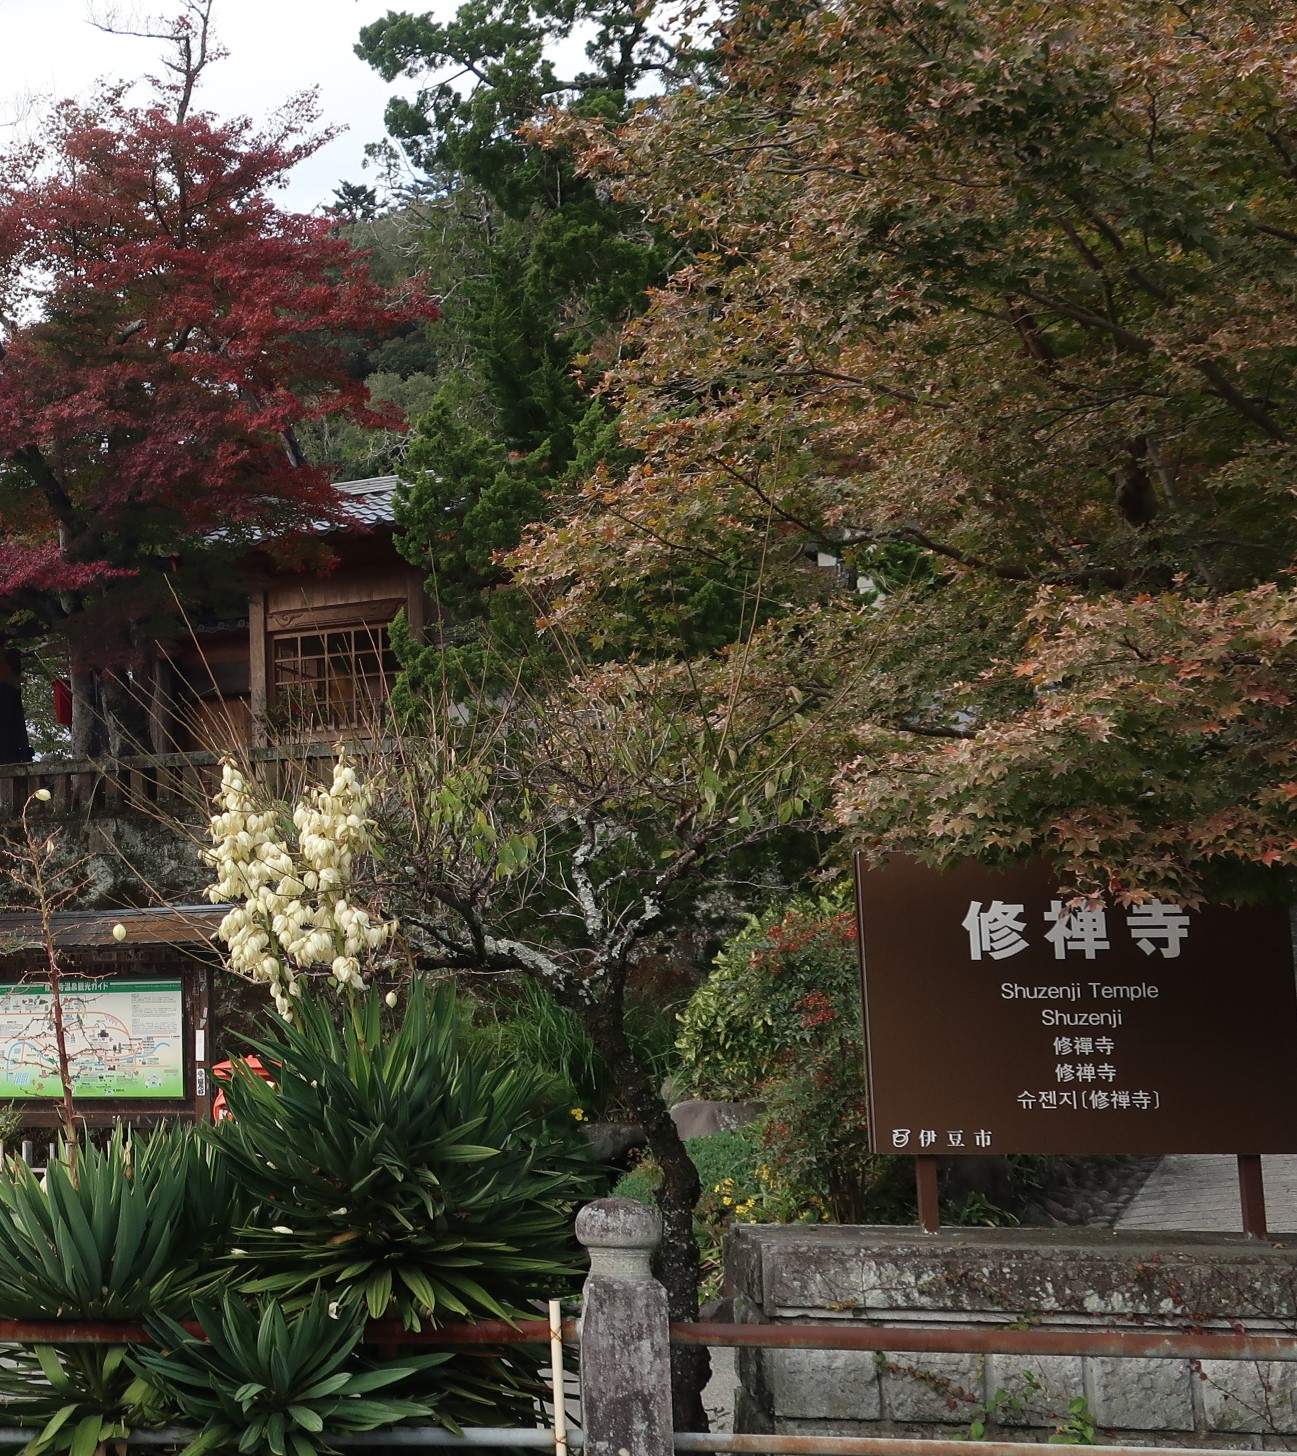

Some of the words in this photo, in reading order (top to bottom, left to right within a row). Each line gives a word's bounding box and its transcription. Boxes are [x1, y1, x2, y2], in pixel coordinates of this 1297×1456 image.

[962, 899, 1190, 961] 修禅寺
[45, 982, 109, 991] 修寺温泉観光ガイド
[1001, 982, 1081, 1002] Shuzenji
[1087, 982, 1160, 1001] Temple
[1041, 1009, 1123, 1029] Shuzenji
[1052, 1035, 1115, 1056] 修禪寺
[1054, 1062, 1117, 1083] 修禅寺
[918, 1128, 994, 1148] 伊豆市
